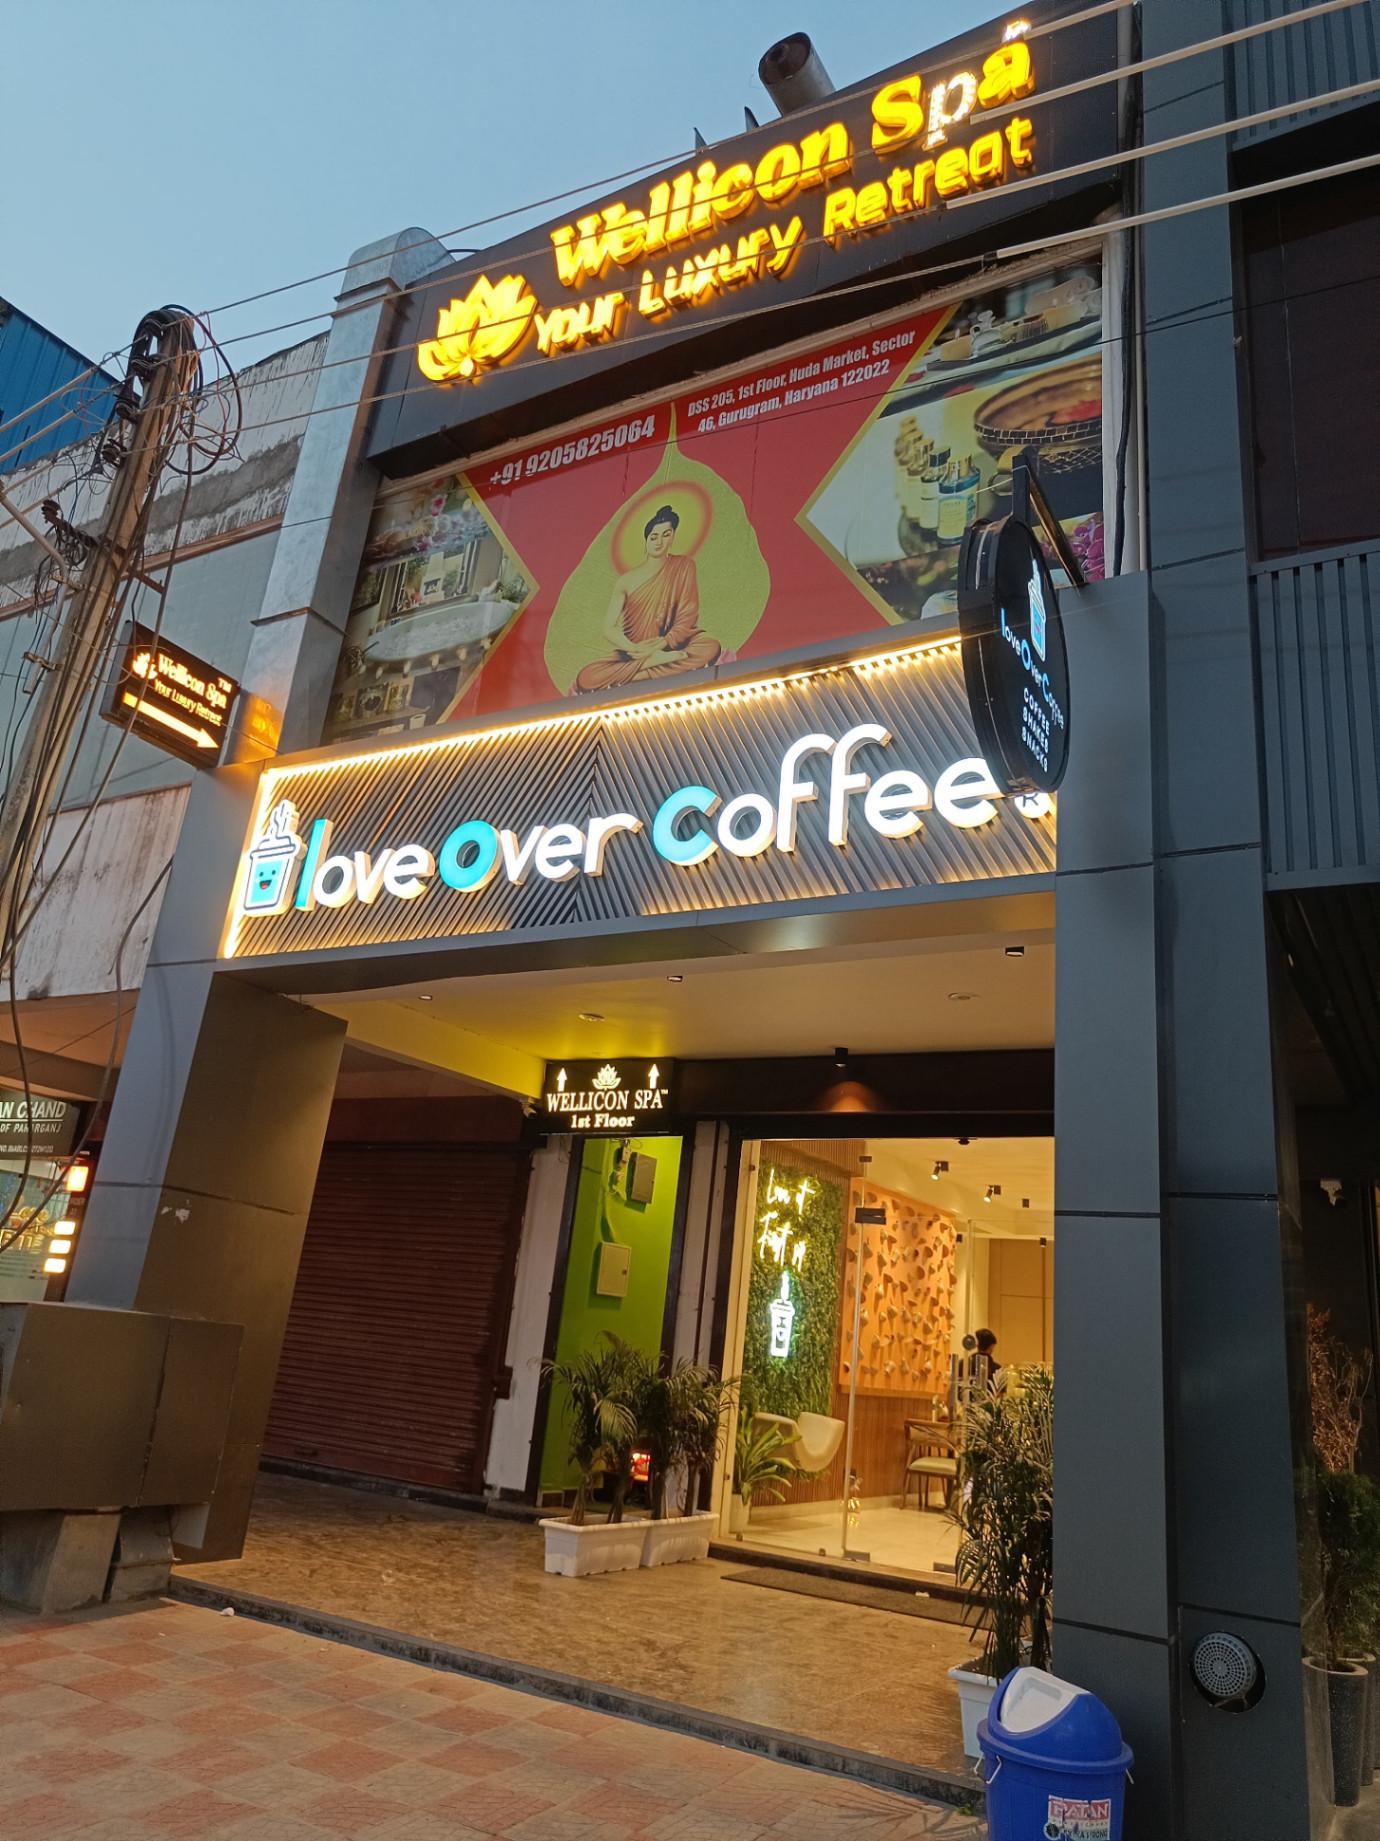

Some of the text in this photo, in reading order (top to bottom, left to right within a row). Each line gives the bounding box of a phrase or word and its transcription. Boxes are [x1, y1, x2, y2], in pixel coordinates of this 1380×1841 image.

[550, 42, 1034, 287] Wellicon Spa
[638, 215, 803, 318] Luxury
[822, 117, 1033, 245] Retreat
[687, 330, 916, 416] DSS 205, 1st Floor, Huda Market, Sector
[698, 358, 890, 432] 46, Gurugram, Haryana 122022
[489, 415, 656, 485] +91 9205825064
[158, 653, 206, 696] Wellicon
[205, 683, 227, 709] Spa
[1022, 706, 1049, 754] SHAKES
[1023, 687, 1050, 736] COFFEE
[1021, 726, 1048, 773] SNACKS
[17, 1101, 67, 1119] CHAND
[546, 1090, 630, 1112] WELLICON
[571, 1113, 635, 1128] 1st Floor
